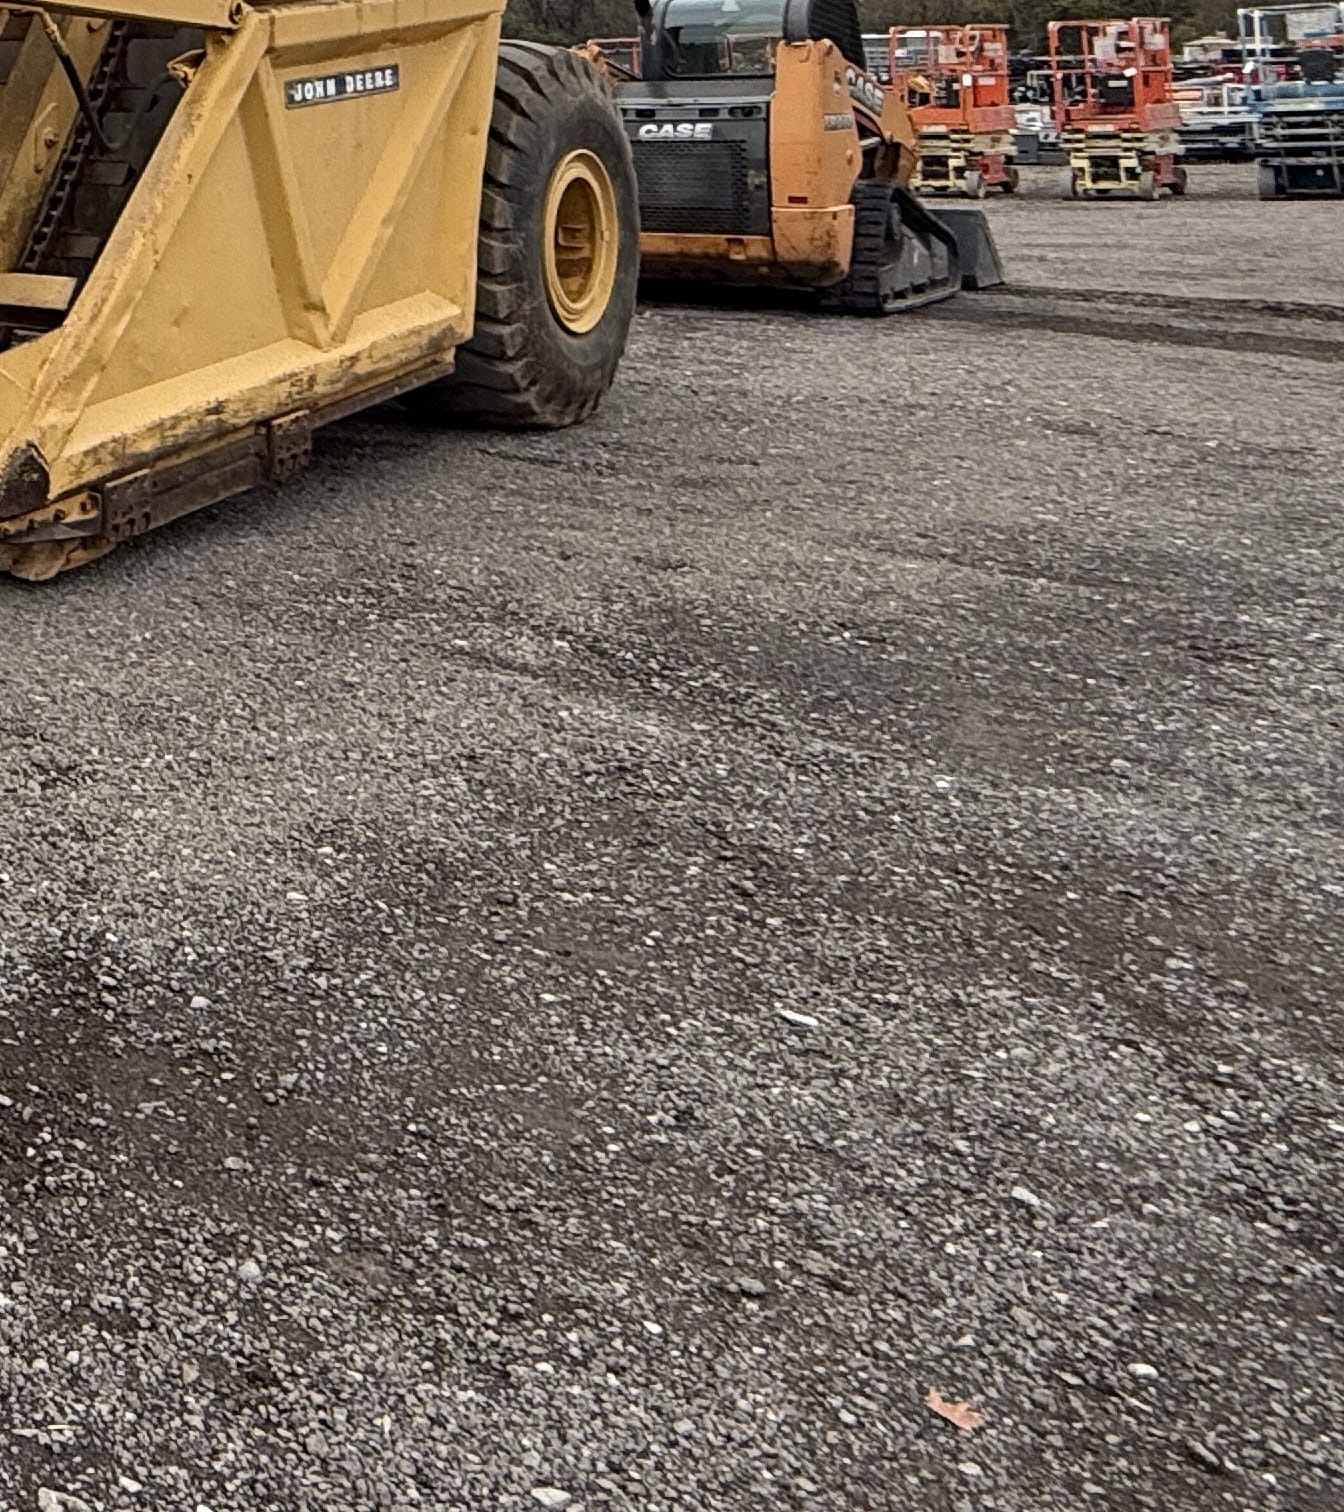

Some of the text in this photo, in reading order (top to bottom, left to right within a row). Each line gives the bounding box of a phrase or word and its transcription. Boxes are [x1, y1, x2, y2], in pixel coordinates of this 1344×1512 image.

[291, 68, 394, 102] JOHN DEERE
[639, 122, 713, 141] CASE
